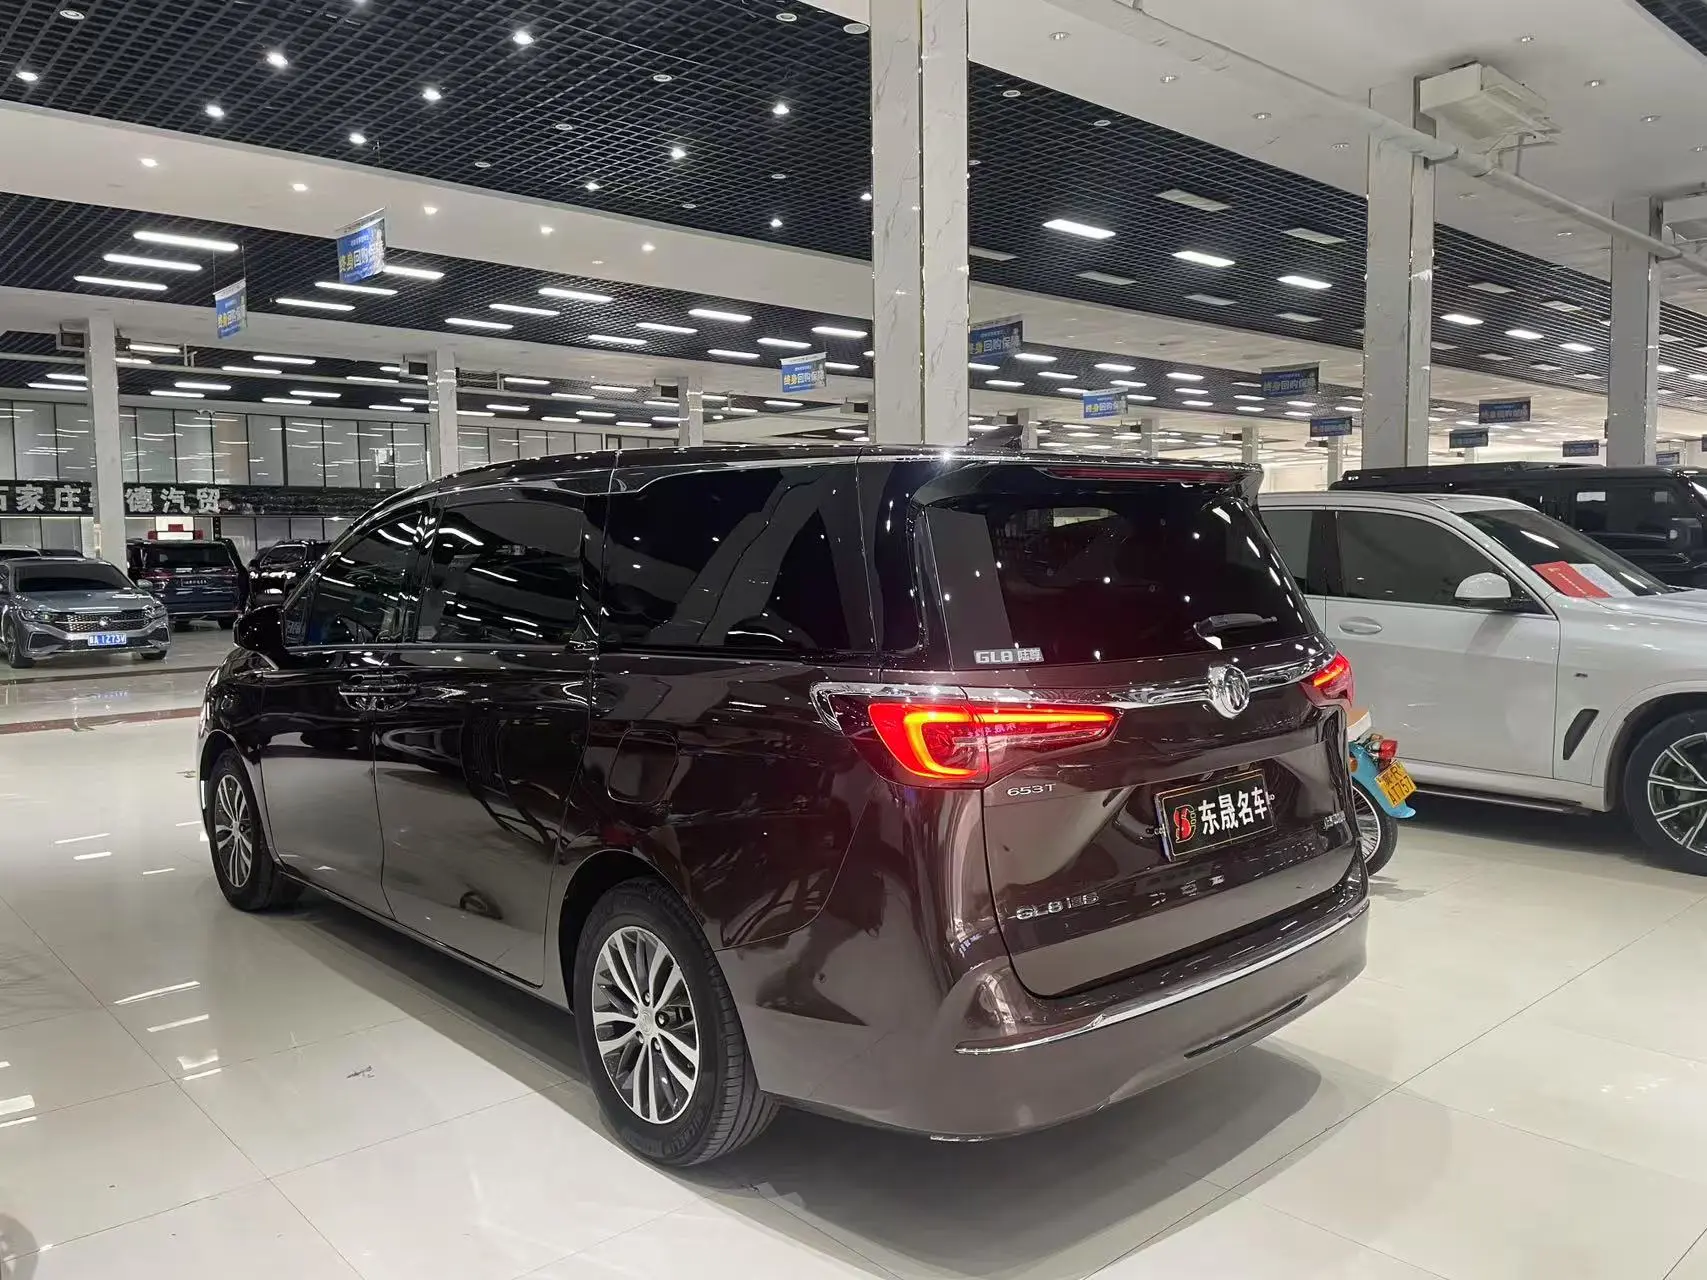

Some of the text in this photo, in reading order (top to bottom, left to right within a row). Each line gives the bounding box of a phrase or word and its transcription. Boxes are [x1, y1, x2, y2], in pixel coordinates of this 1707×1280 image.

[0, 483, 220, 514] 家庄德汽贸
[975, 650, 1014, 664] GL8
[1007, 782, 1057, 797] 653T
[1197, 786, 1268, 836] 东晟名车
